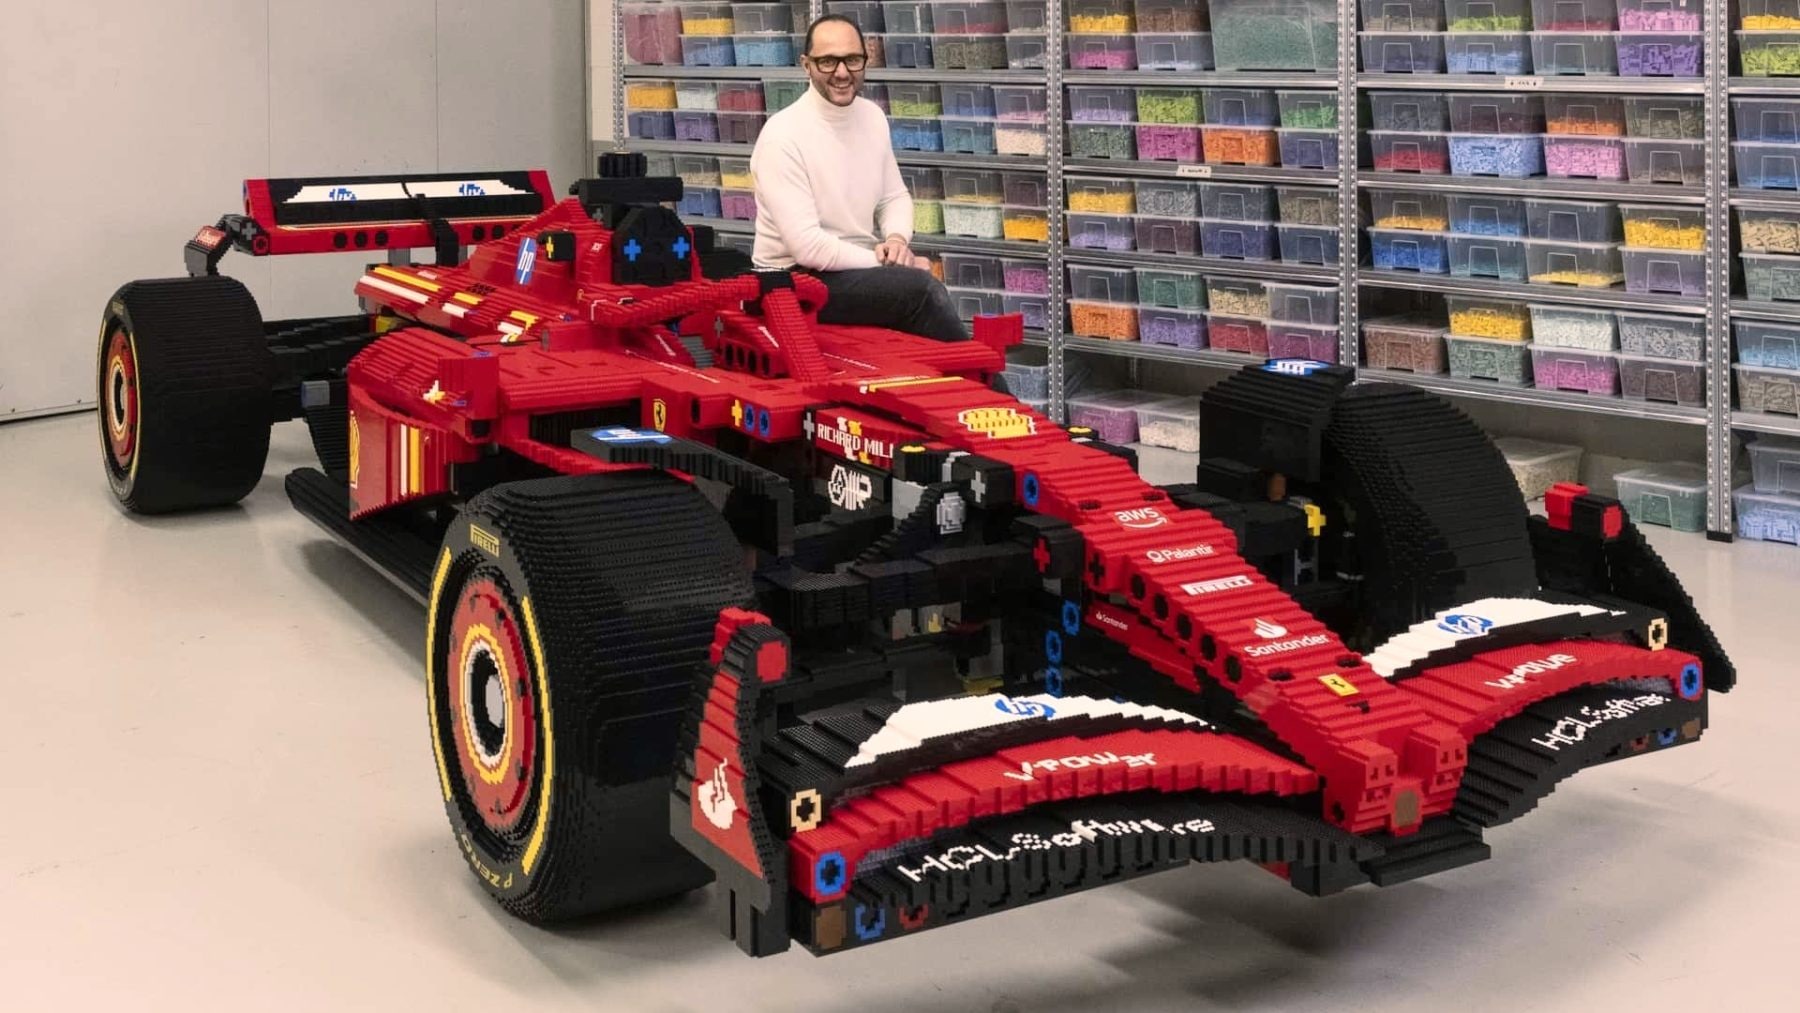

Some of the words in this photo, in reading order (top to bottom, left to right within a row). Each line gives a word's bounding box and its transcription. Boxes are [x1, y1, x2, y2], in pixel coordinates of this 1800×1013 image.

[516, 237, 535, 284] hp
[816, 423, 861, 451] RICHARD
[1114, 507, 1160, 522] aws
[470, 523, 500, 558] PIRELLI
[1164, 544, 1214, 561] Palantir
[1244, 634, 1330, 658] Santander
[461, 834, 500, 889] ZERO
